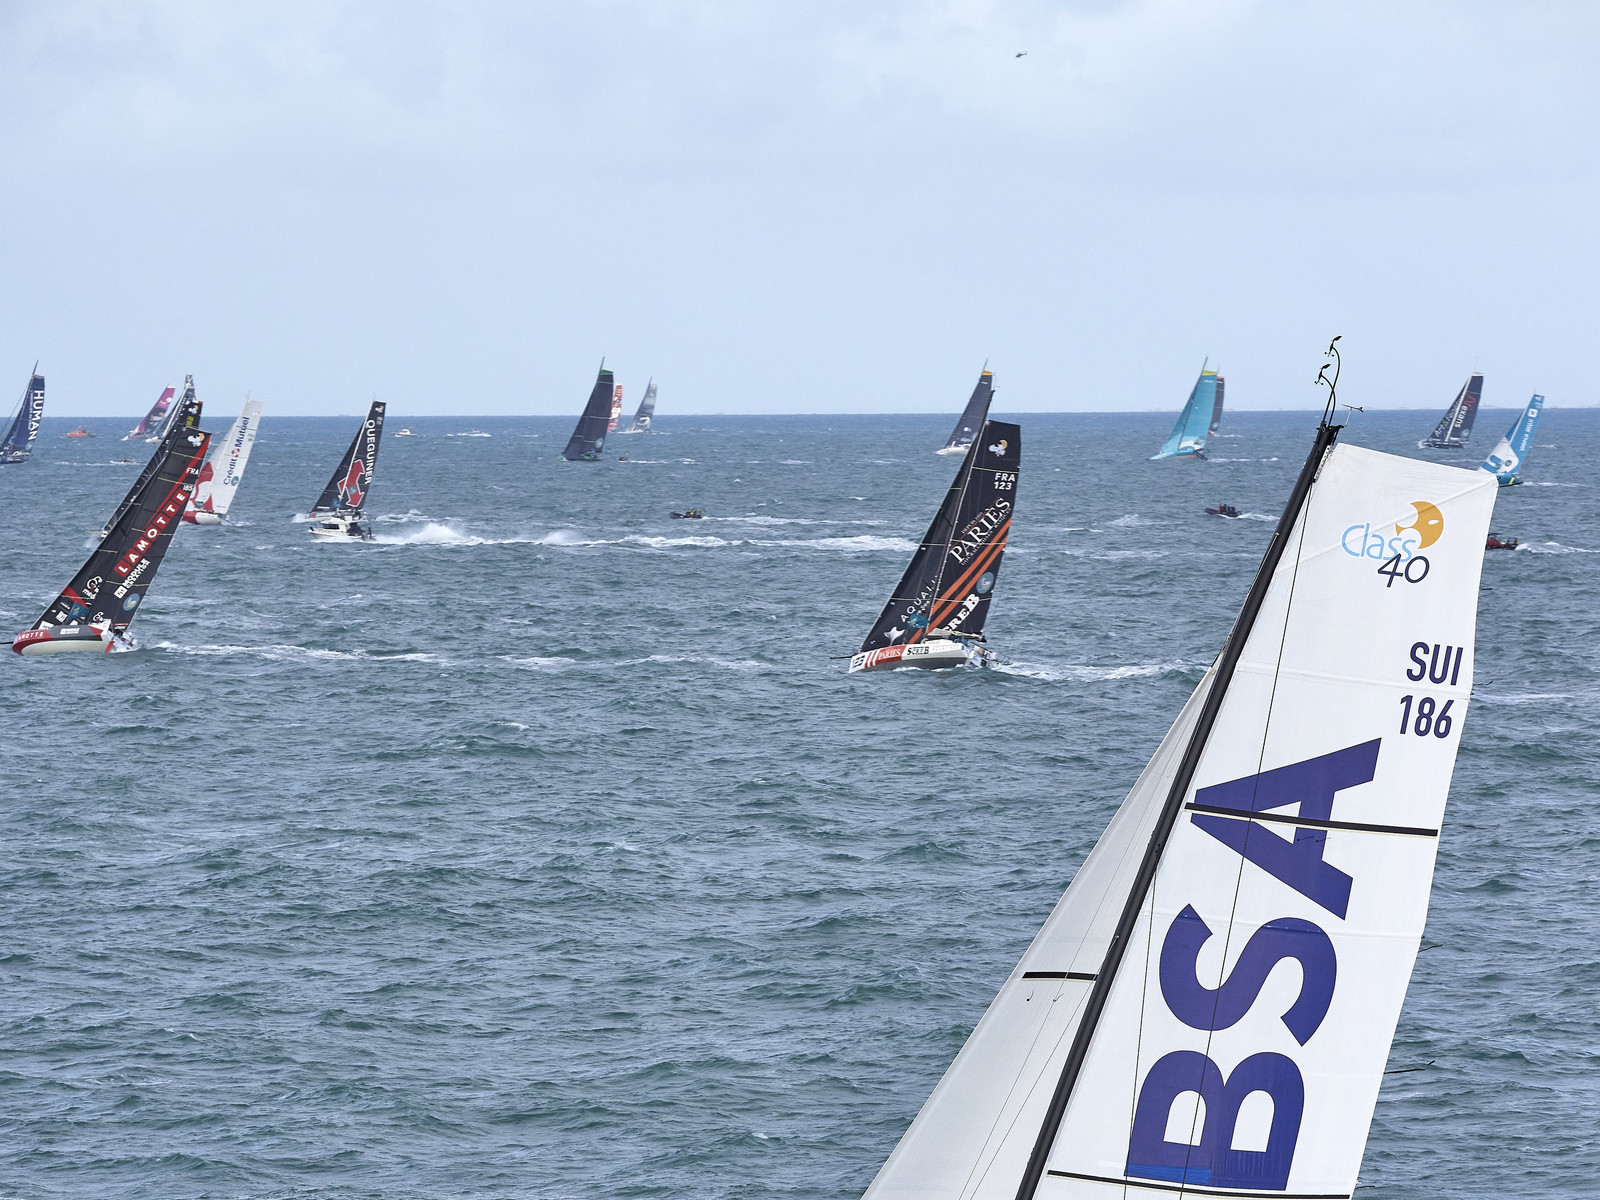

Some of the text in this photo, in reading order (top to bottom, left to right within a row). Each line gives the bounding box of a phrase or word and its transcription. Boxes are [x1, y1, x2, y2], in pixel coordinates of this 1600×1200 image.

[28, 390, 44, 440] HUMAN
[186, 467, 199, 475] FRA
[223, 416, 250, 485] Crédit Mutuel
[365, 419, 376, 485] QUEGUINER
[993, 481, 1012, 490] 123
[994, 472, 1016, 482] FRA
[118, 492, 186, 574] LAMOTTE
[949, 497, 1011, 563] PARIÈS
[1341, 522, 1416, 562] Class
[122, 558, 148, 587] MODULE
[1377, 553, 1430, 587] 40
[1406, 642, 1463, 686] SUI
[1400, 695, 1454, 739] 186
